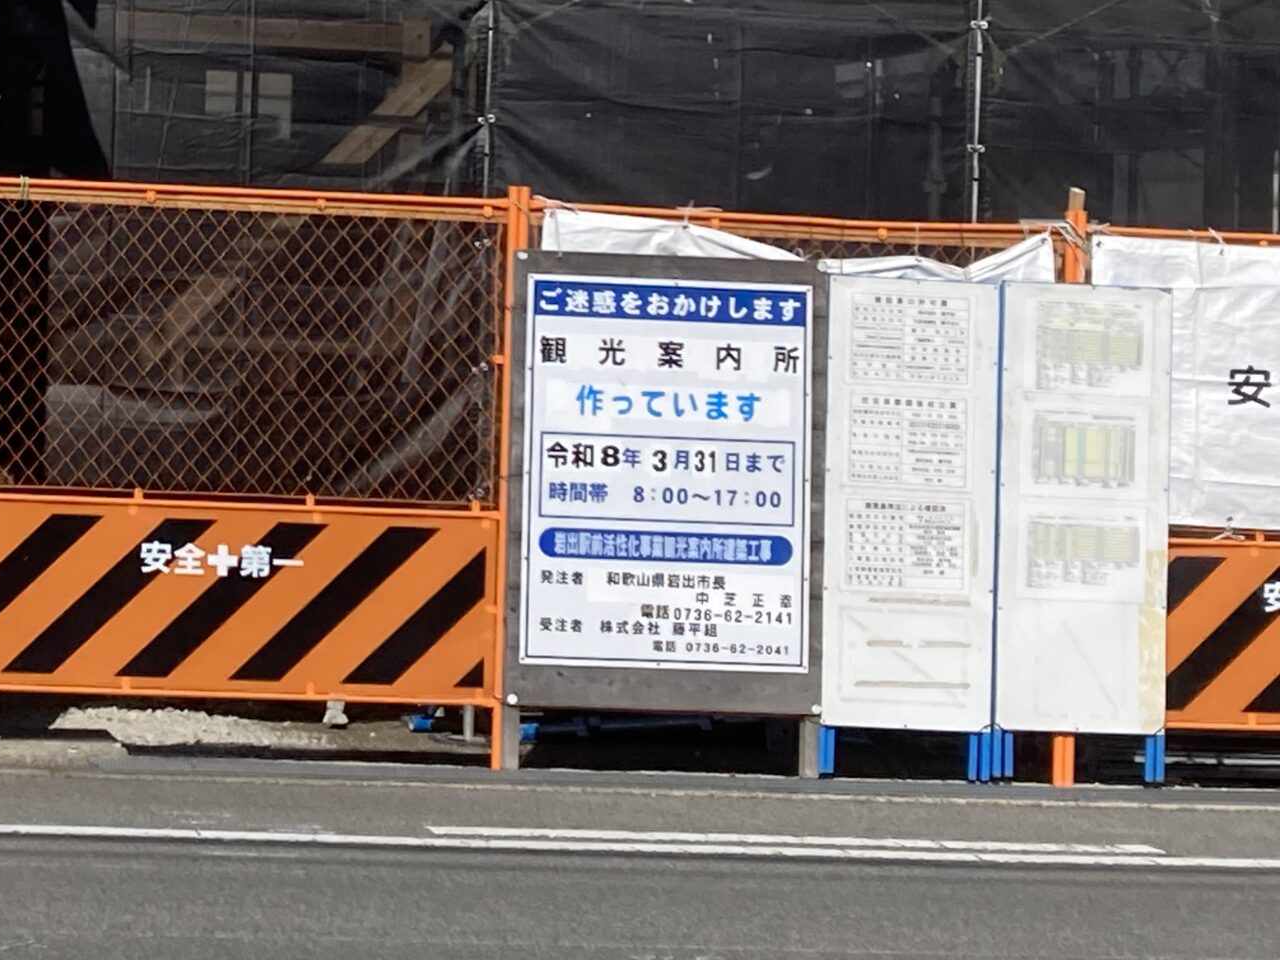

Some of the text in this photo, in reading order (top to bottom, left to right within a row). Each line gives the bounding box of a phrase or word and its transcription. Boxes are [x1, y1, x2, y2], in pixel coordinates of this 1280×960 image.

[540, 288, 801, 322] ご迷惑をおかけします
[540, 336, 800, 374] 観光案内所
[1228, 365, 1272, 407] 安
[576, 385, 761, 422] 作っています
[549, 481, 609, 503] 時間帯
[541, 569, 726, 591] 発注者 和歌山県岩出市長
[539, 617, 582, 633] 受注者
[600, 620, 661, 636] 株式会社
